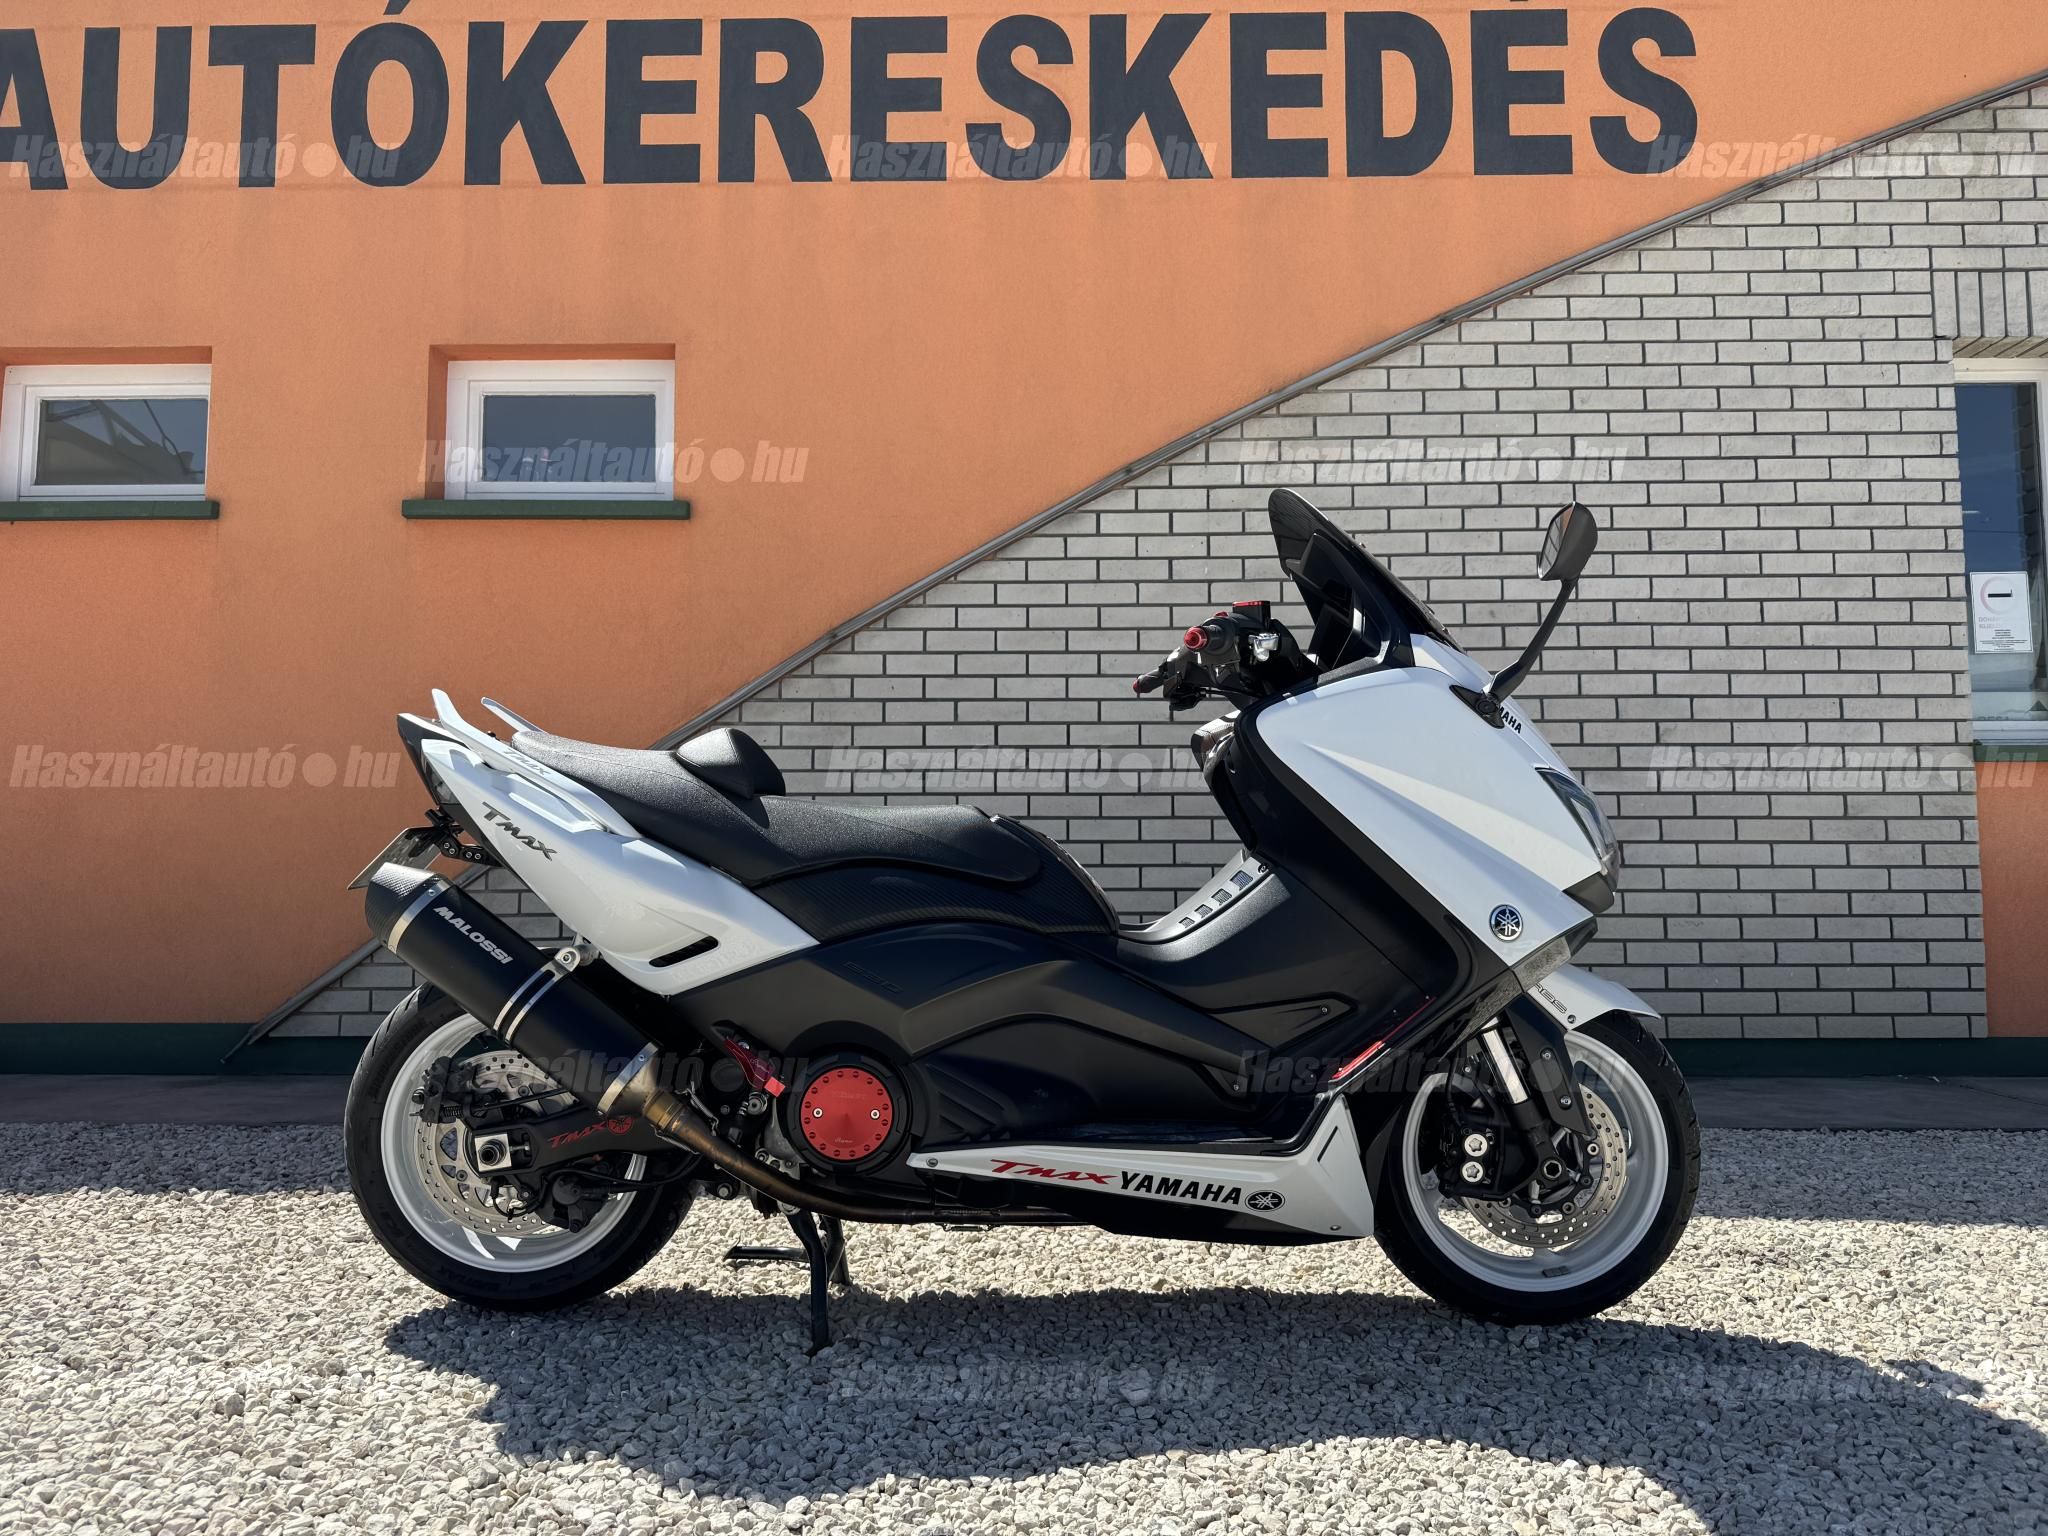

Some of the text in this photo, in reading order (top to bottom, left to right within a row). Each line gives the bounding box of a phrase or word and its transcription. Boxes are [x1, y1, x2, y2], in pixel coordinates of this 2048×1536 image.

[482, 801, 557, 862] TMAX
[433, 906, 514, 965] MALOSSI
[991, 1159, 1242, 1204] TMAX YAMAHA
